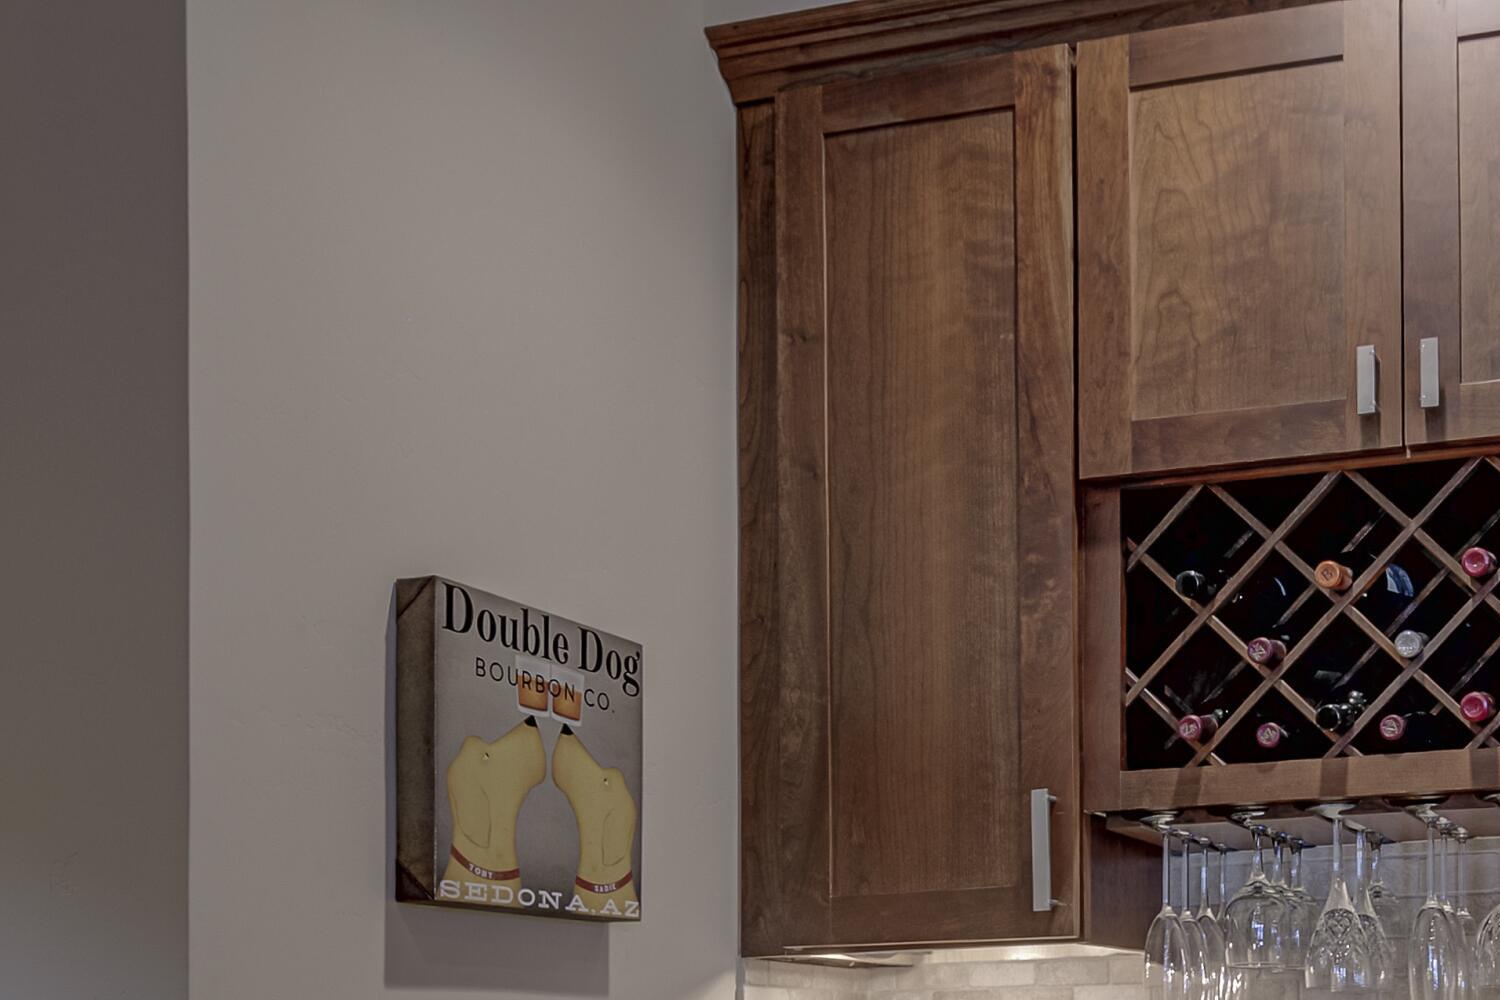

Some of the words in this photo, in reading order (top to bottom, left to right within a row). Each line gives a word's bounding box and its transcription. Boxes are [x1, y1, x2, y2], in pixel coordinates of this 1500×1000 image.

[442, 581, 569, 664] Double
[578, 626, 640, 696] Dog
[476, 657, 575, 702] BOURBON
[584, 689, 615, 713] CO.
